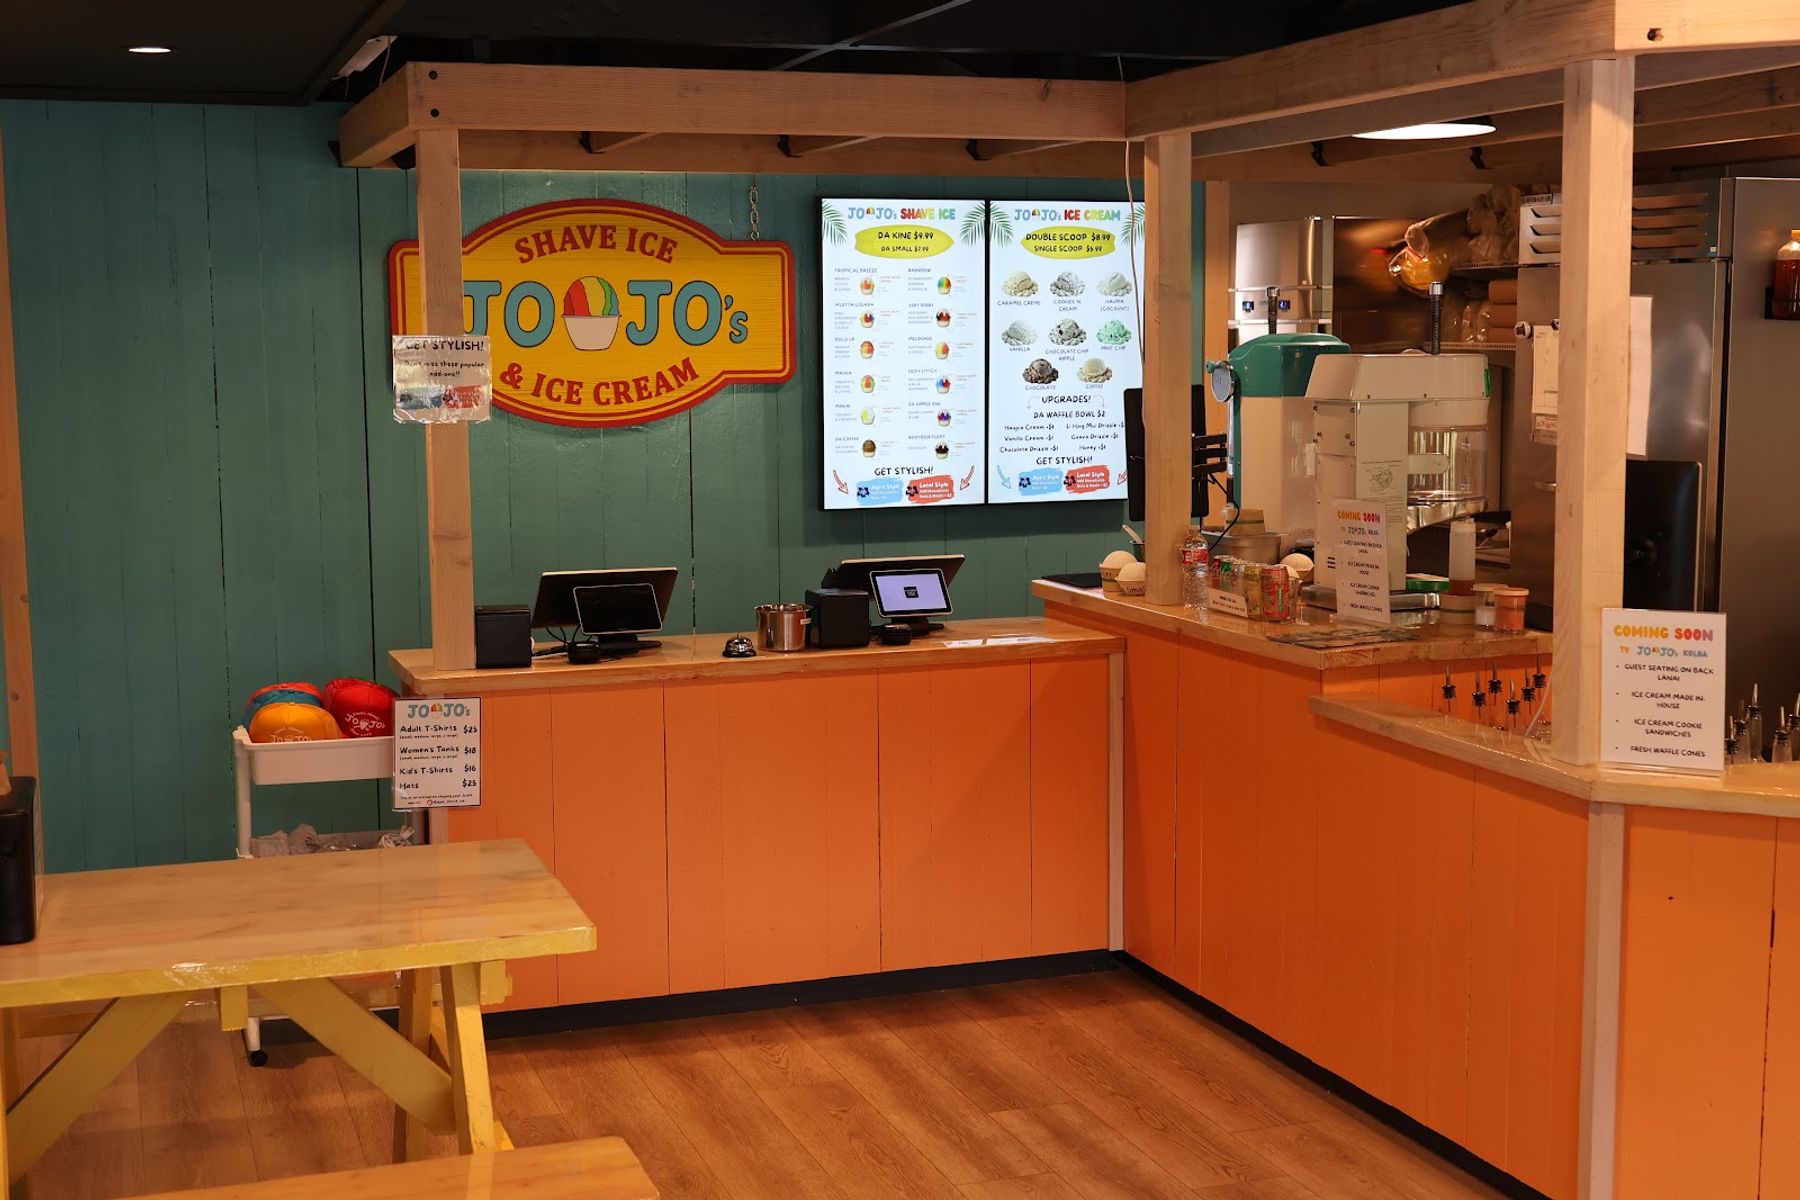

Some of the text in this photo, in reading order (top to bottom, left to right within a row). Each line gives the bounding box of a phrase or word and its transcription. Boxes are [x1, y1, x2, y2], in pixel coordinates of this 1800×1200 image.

[848, 207, 865, 220] JO
[900, 208, 935, 220] SHAVE
[938, 208, 956, 220] ICE
[1014, 210, 1030, 221] JO
[1064, 210, 1081, 221] ICE
[1084, 210, 1120, 221] CREAM
[892, 232, 911, 240] KINE
[1026, 232, 1111, 242] DOUBLE SCOOP $8.99
[514, 225, 678, 264] SHAVE ICE
[463, 280, 749, 348] JO JO's
[432, 340, 484, 351] STYLISH!
[500, 357, 700, 407] & ICE CREAM
[1041, 395, 1092, 404] UPGRADES!
[1075, 410, 1095, 418] BOWL
[1097, 410, 1106, 418] $2
[1036, 456, 1093, 465] GET STYLISH!
[874, 466, 934, 476] GET STYLISH!
[1614, 624, 1714, 641] COMING SOON
[1619, 646, 1630, 654] TO
[1636, 646, 1651, 656] JO
[1648, 664, 1679, 673] SEATING
[1693, 667, 1714, 675] BACK
[1673, 693, 1694, 701] MADE
[408, 704, 471, 718] JO JO's
[425, 724, 457, 733] T-Shirts
[463, 725, 478, 734] $25
[1647, 719, 1674, 727] CREAM
[1675, 722, 1702, 730] COOKIE
[1645, 728, 1692, 738] SANDWICHES
[400, 746, 434, 754] Women's
[464, 746, 477, 755] $18
[1653, 747, 1680, 755] WAFFLE
[1681, 750, 1706, 758] CONES
[421, 766, 453, 775] T-Shirts
[464, 764, 477, 773] $16
[400, 779, 477, 790] Hats $25
